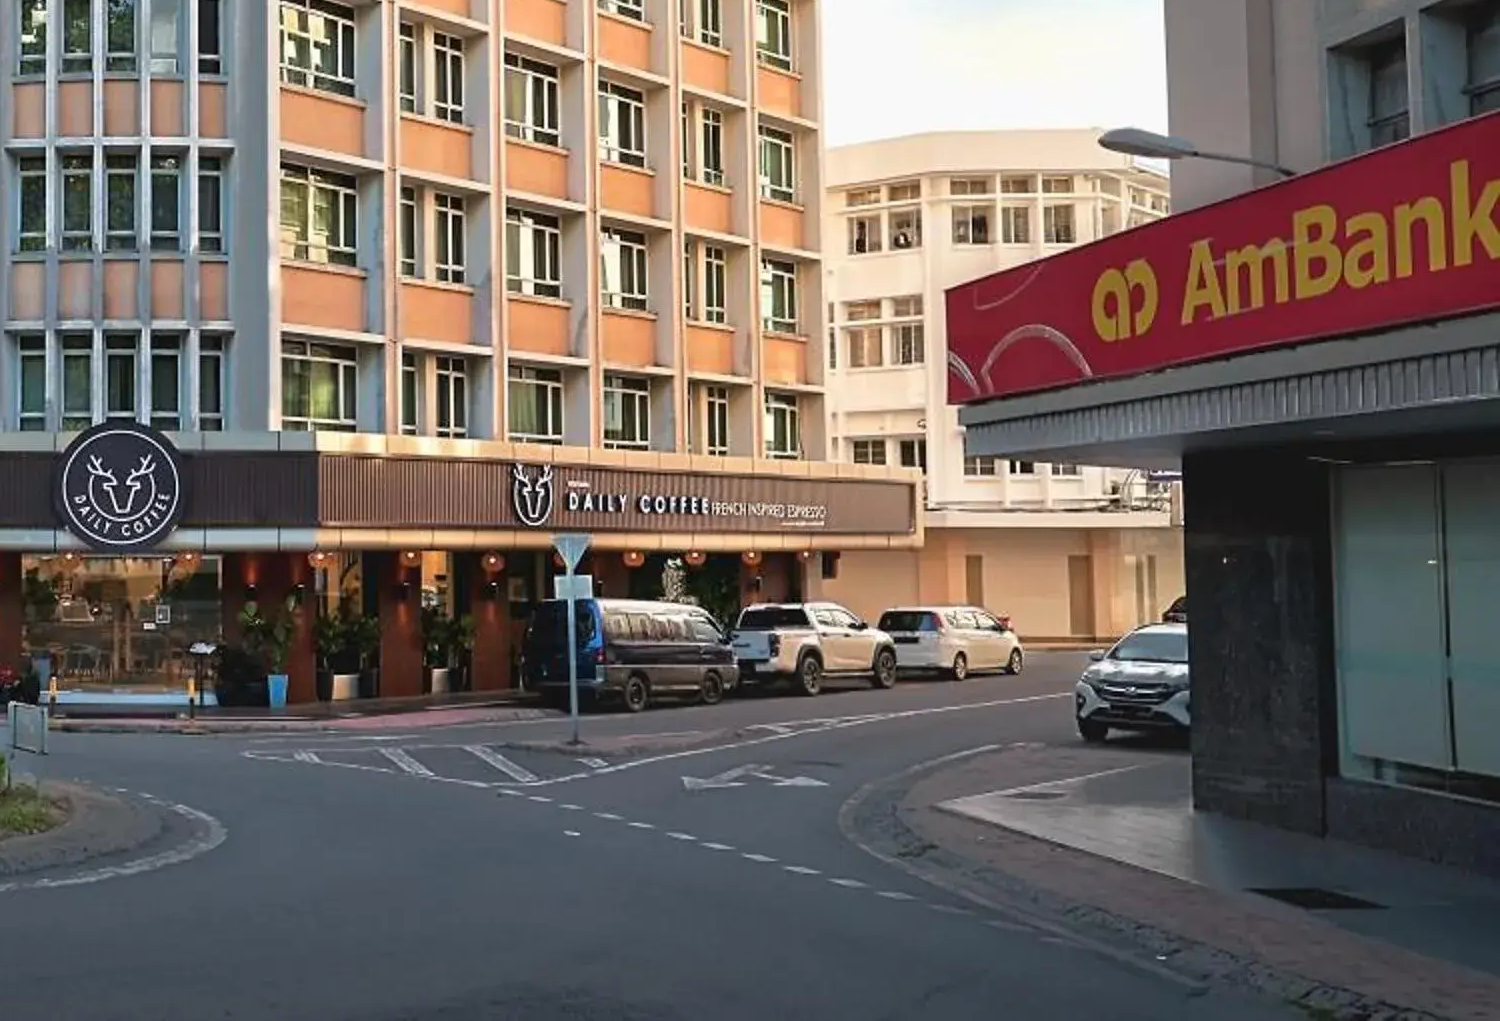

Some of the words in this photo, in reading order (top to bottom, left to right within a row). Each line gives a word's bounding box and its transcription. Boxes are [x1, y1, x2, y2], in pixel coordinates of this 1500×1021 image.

[1181, 159, 1500, 325] AmBank
[73, 494, 113, 534] DAILY
[121, 493, 171, 537] COFFEE
[569, 492, 627, 514] DAILY
[640, 494, 709, 515] COFFEE
